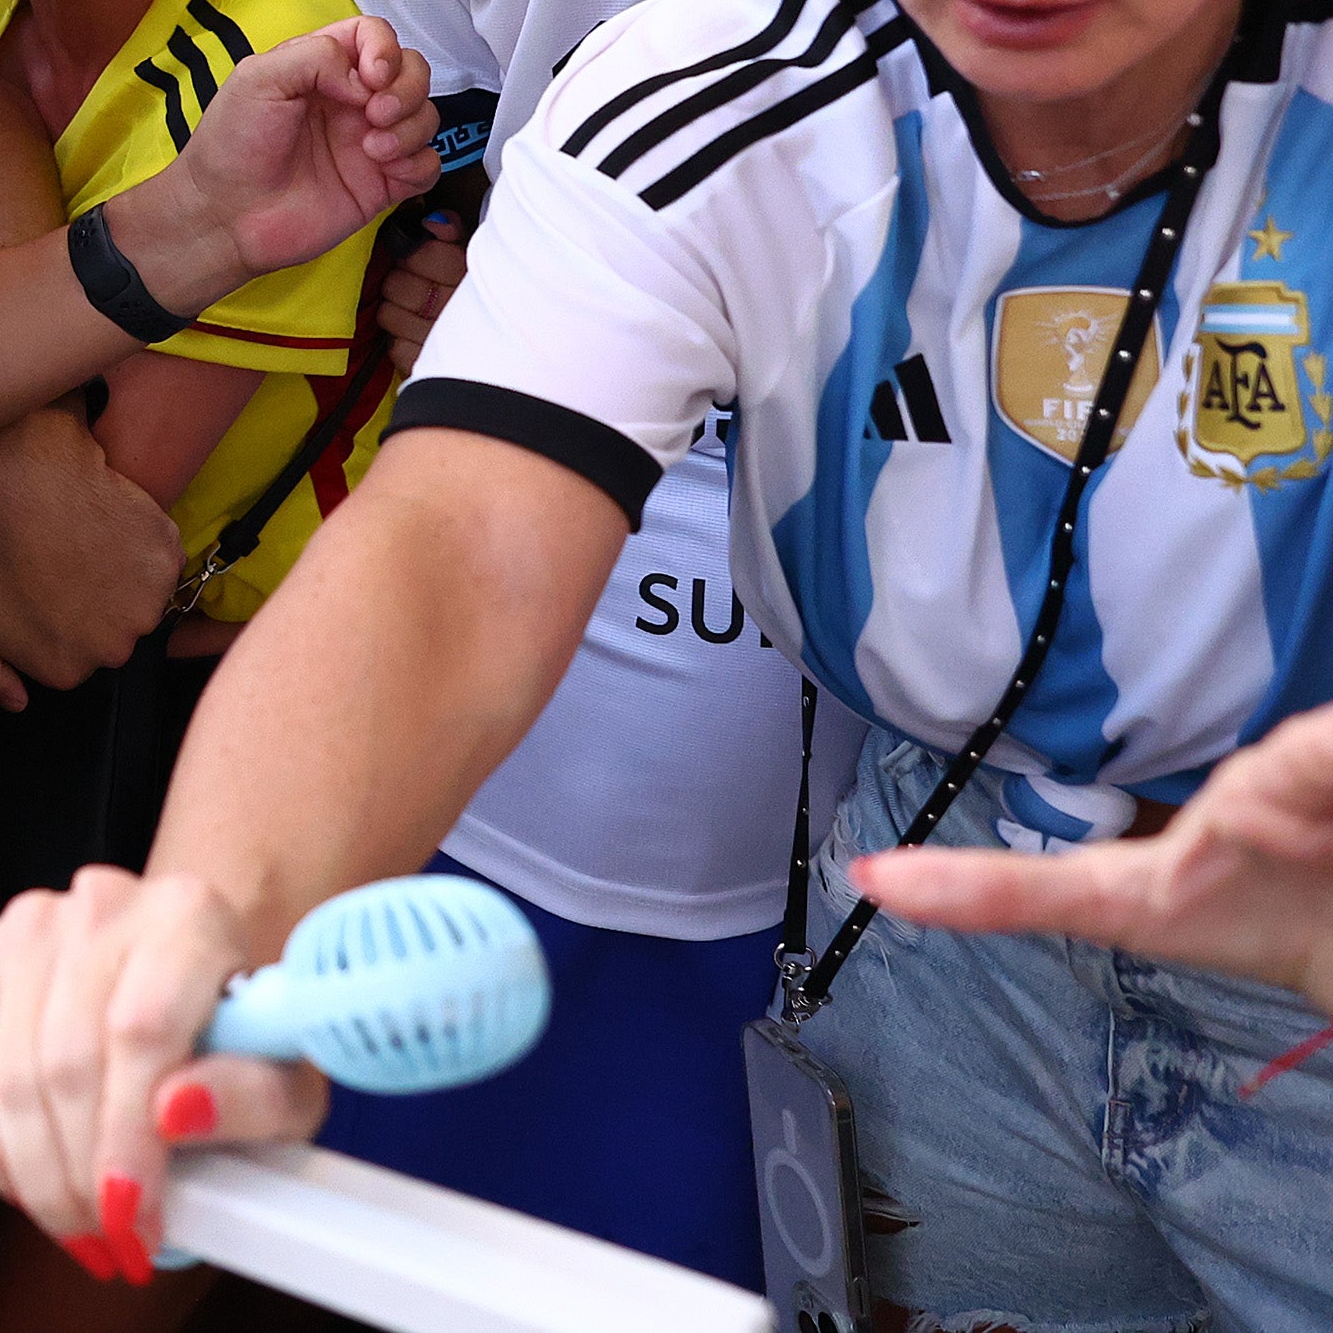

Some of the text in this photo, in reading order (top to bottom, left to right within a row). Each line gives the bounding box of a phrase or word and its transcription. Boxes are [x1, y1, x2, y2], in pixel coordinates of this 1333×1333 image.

[1042, 398, 1094, 420] FIF
[1201, 337, 1286, 429] AFA
[635, 572, 774, 649] SU
